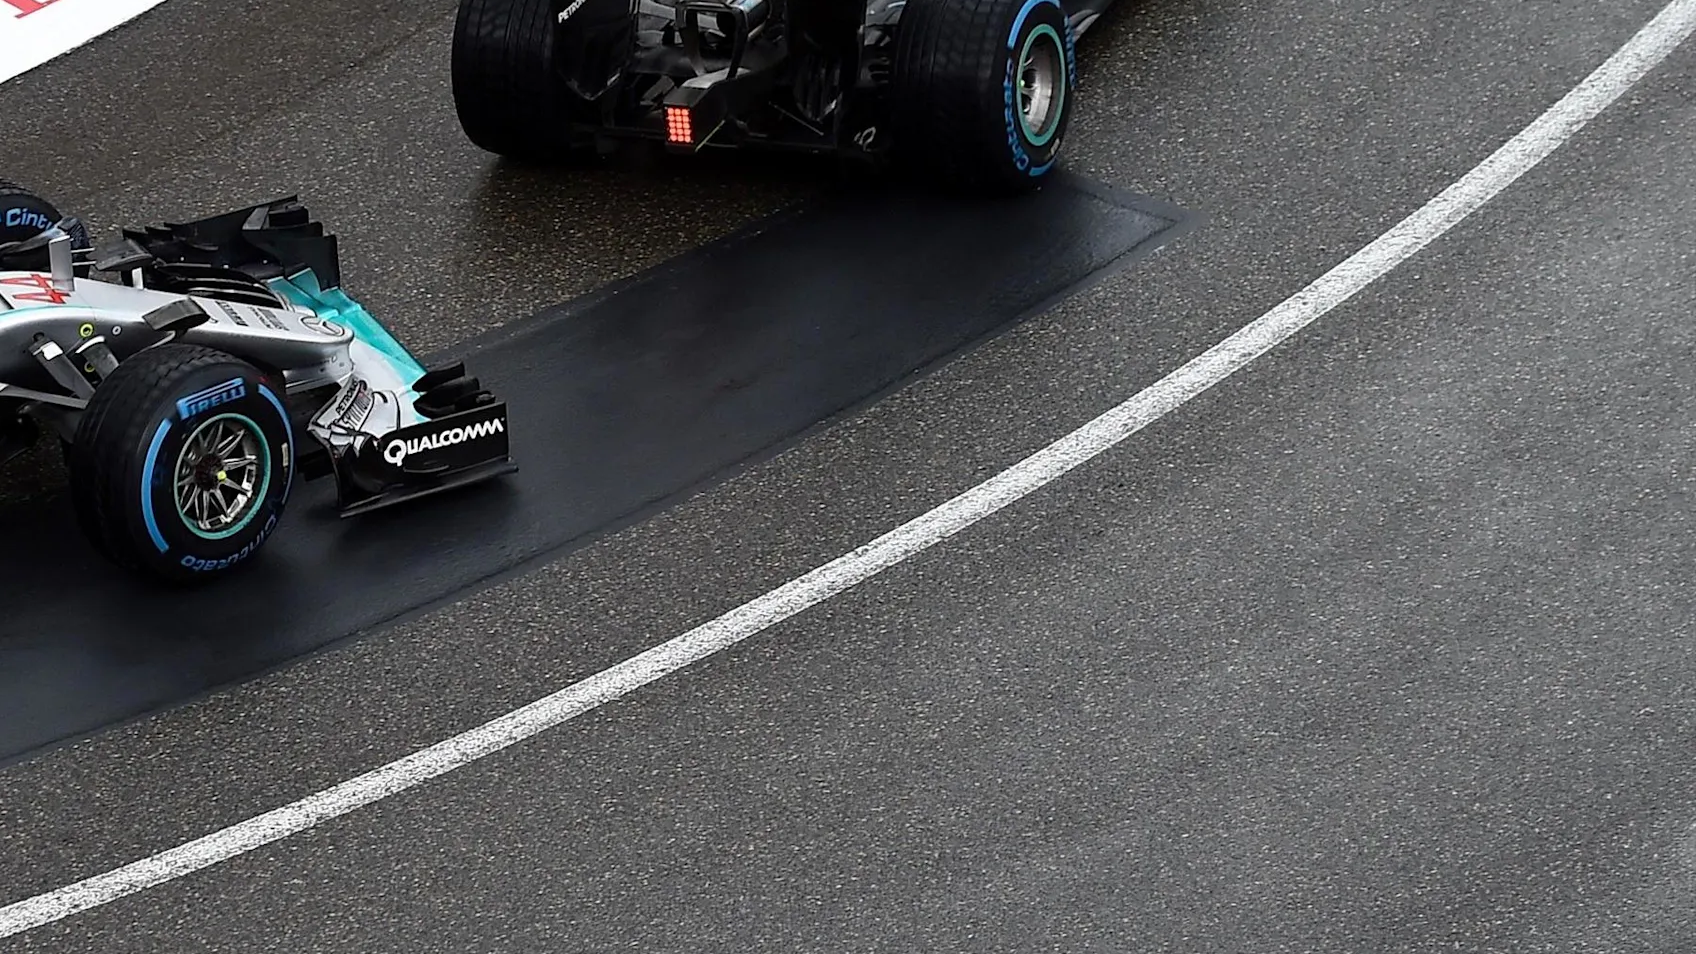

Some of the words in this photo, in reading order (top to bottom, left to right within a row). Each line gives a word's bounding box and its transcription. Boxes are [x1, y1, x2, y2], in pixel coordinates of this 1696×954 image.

[176, 377, 246, 421] PIRELLI
[335, 376, 359, 416] PETRON
[383, 418, 504, 467] QUALCOMM
